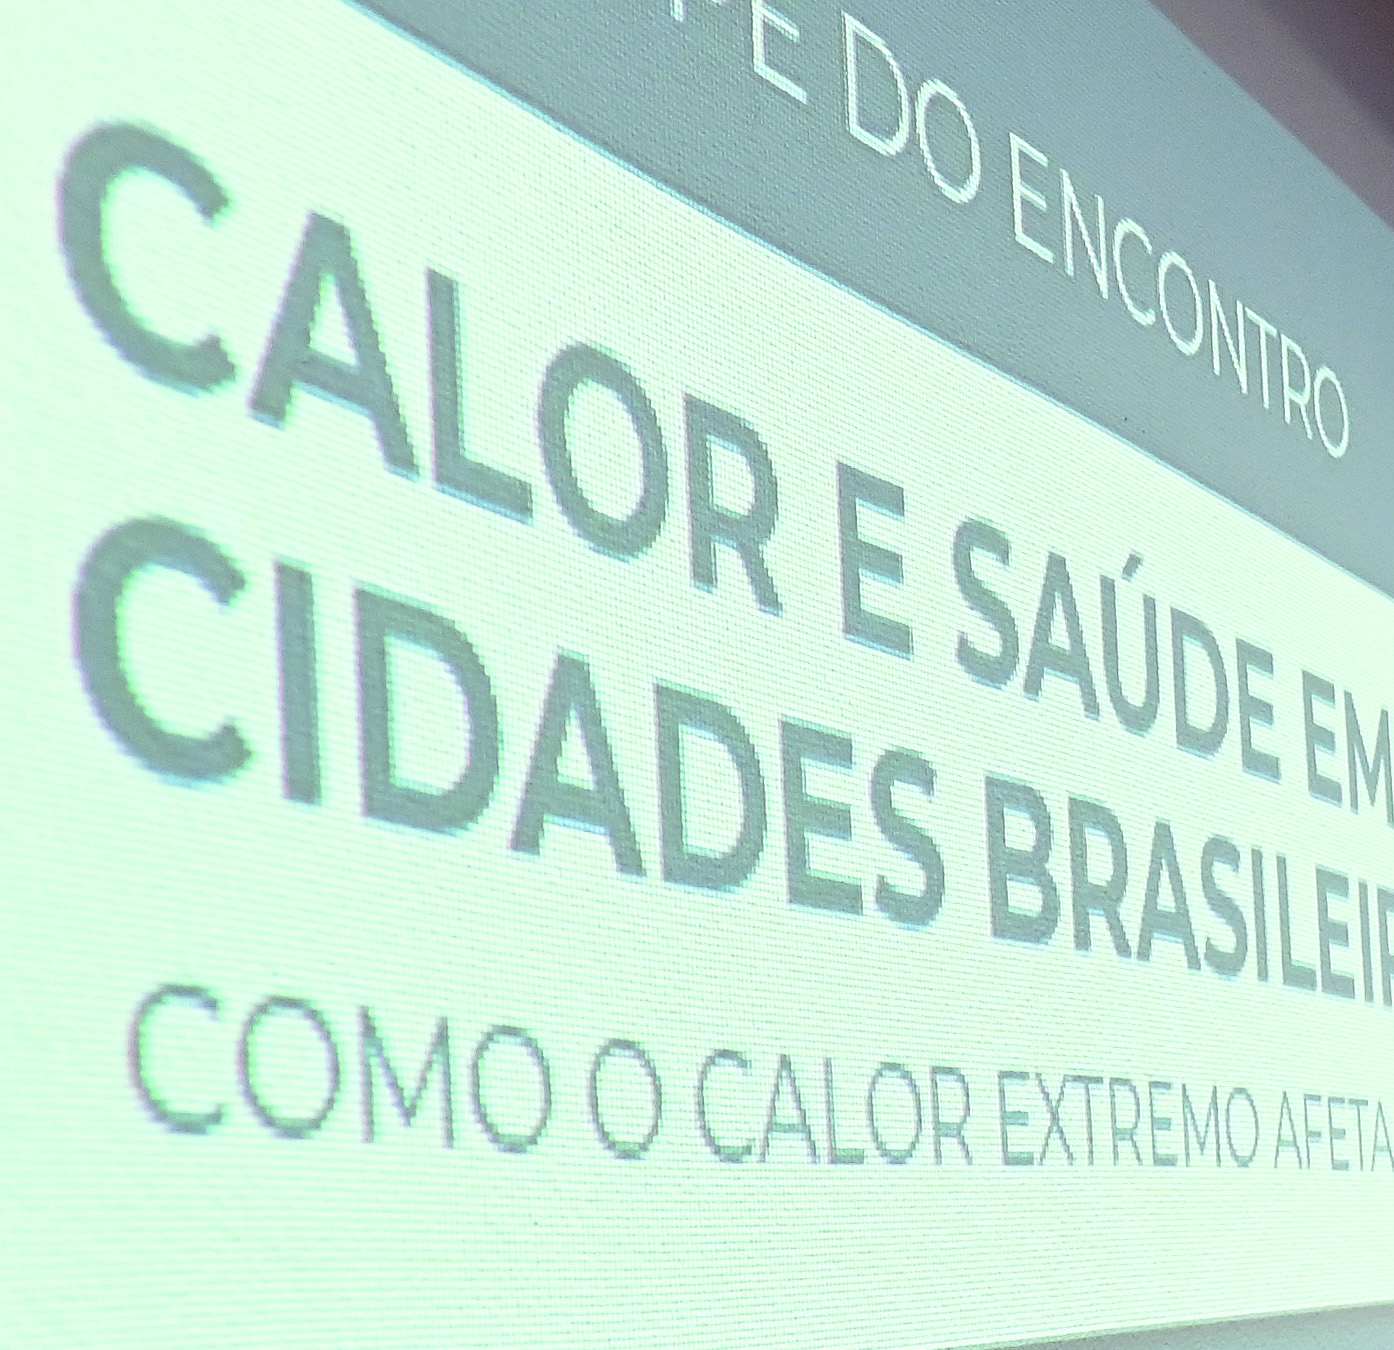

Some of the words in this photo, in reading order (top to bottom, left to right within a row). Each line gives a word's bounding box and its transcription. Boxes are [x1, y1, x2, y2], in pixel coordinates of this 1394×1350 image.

[670, 0, 807, 104] E
[841, 10, 981, 204] DO
[1009, 131, 1349, 458] ENCONTRO
[56, 120, 783, 617] CALOR
[836, 461, 913, 660] E
[952, 516, 1281, 783] SAÚDE
[72, 516, 946, 928] CIDADES
[127, 984, 552, 1154] COMO
[588, 1039, 663, 1161] O
[696, 1049, 972, 1167] CALOR
[998, 1070, 1260, 1169] EXTREMO
[1274, 1090, 1394, 1171] AFETA
